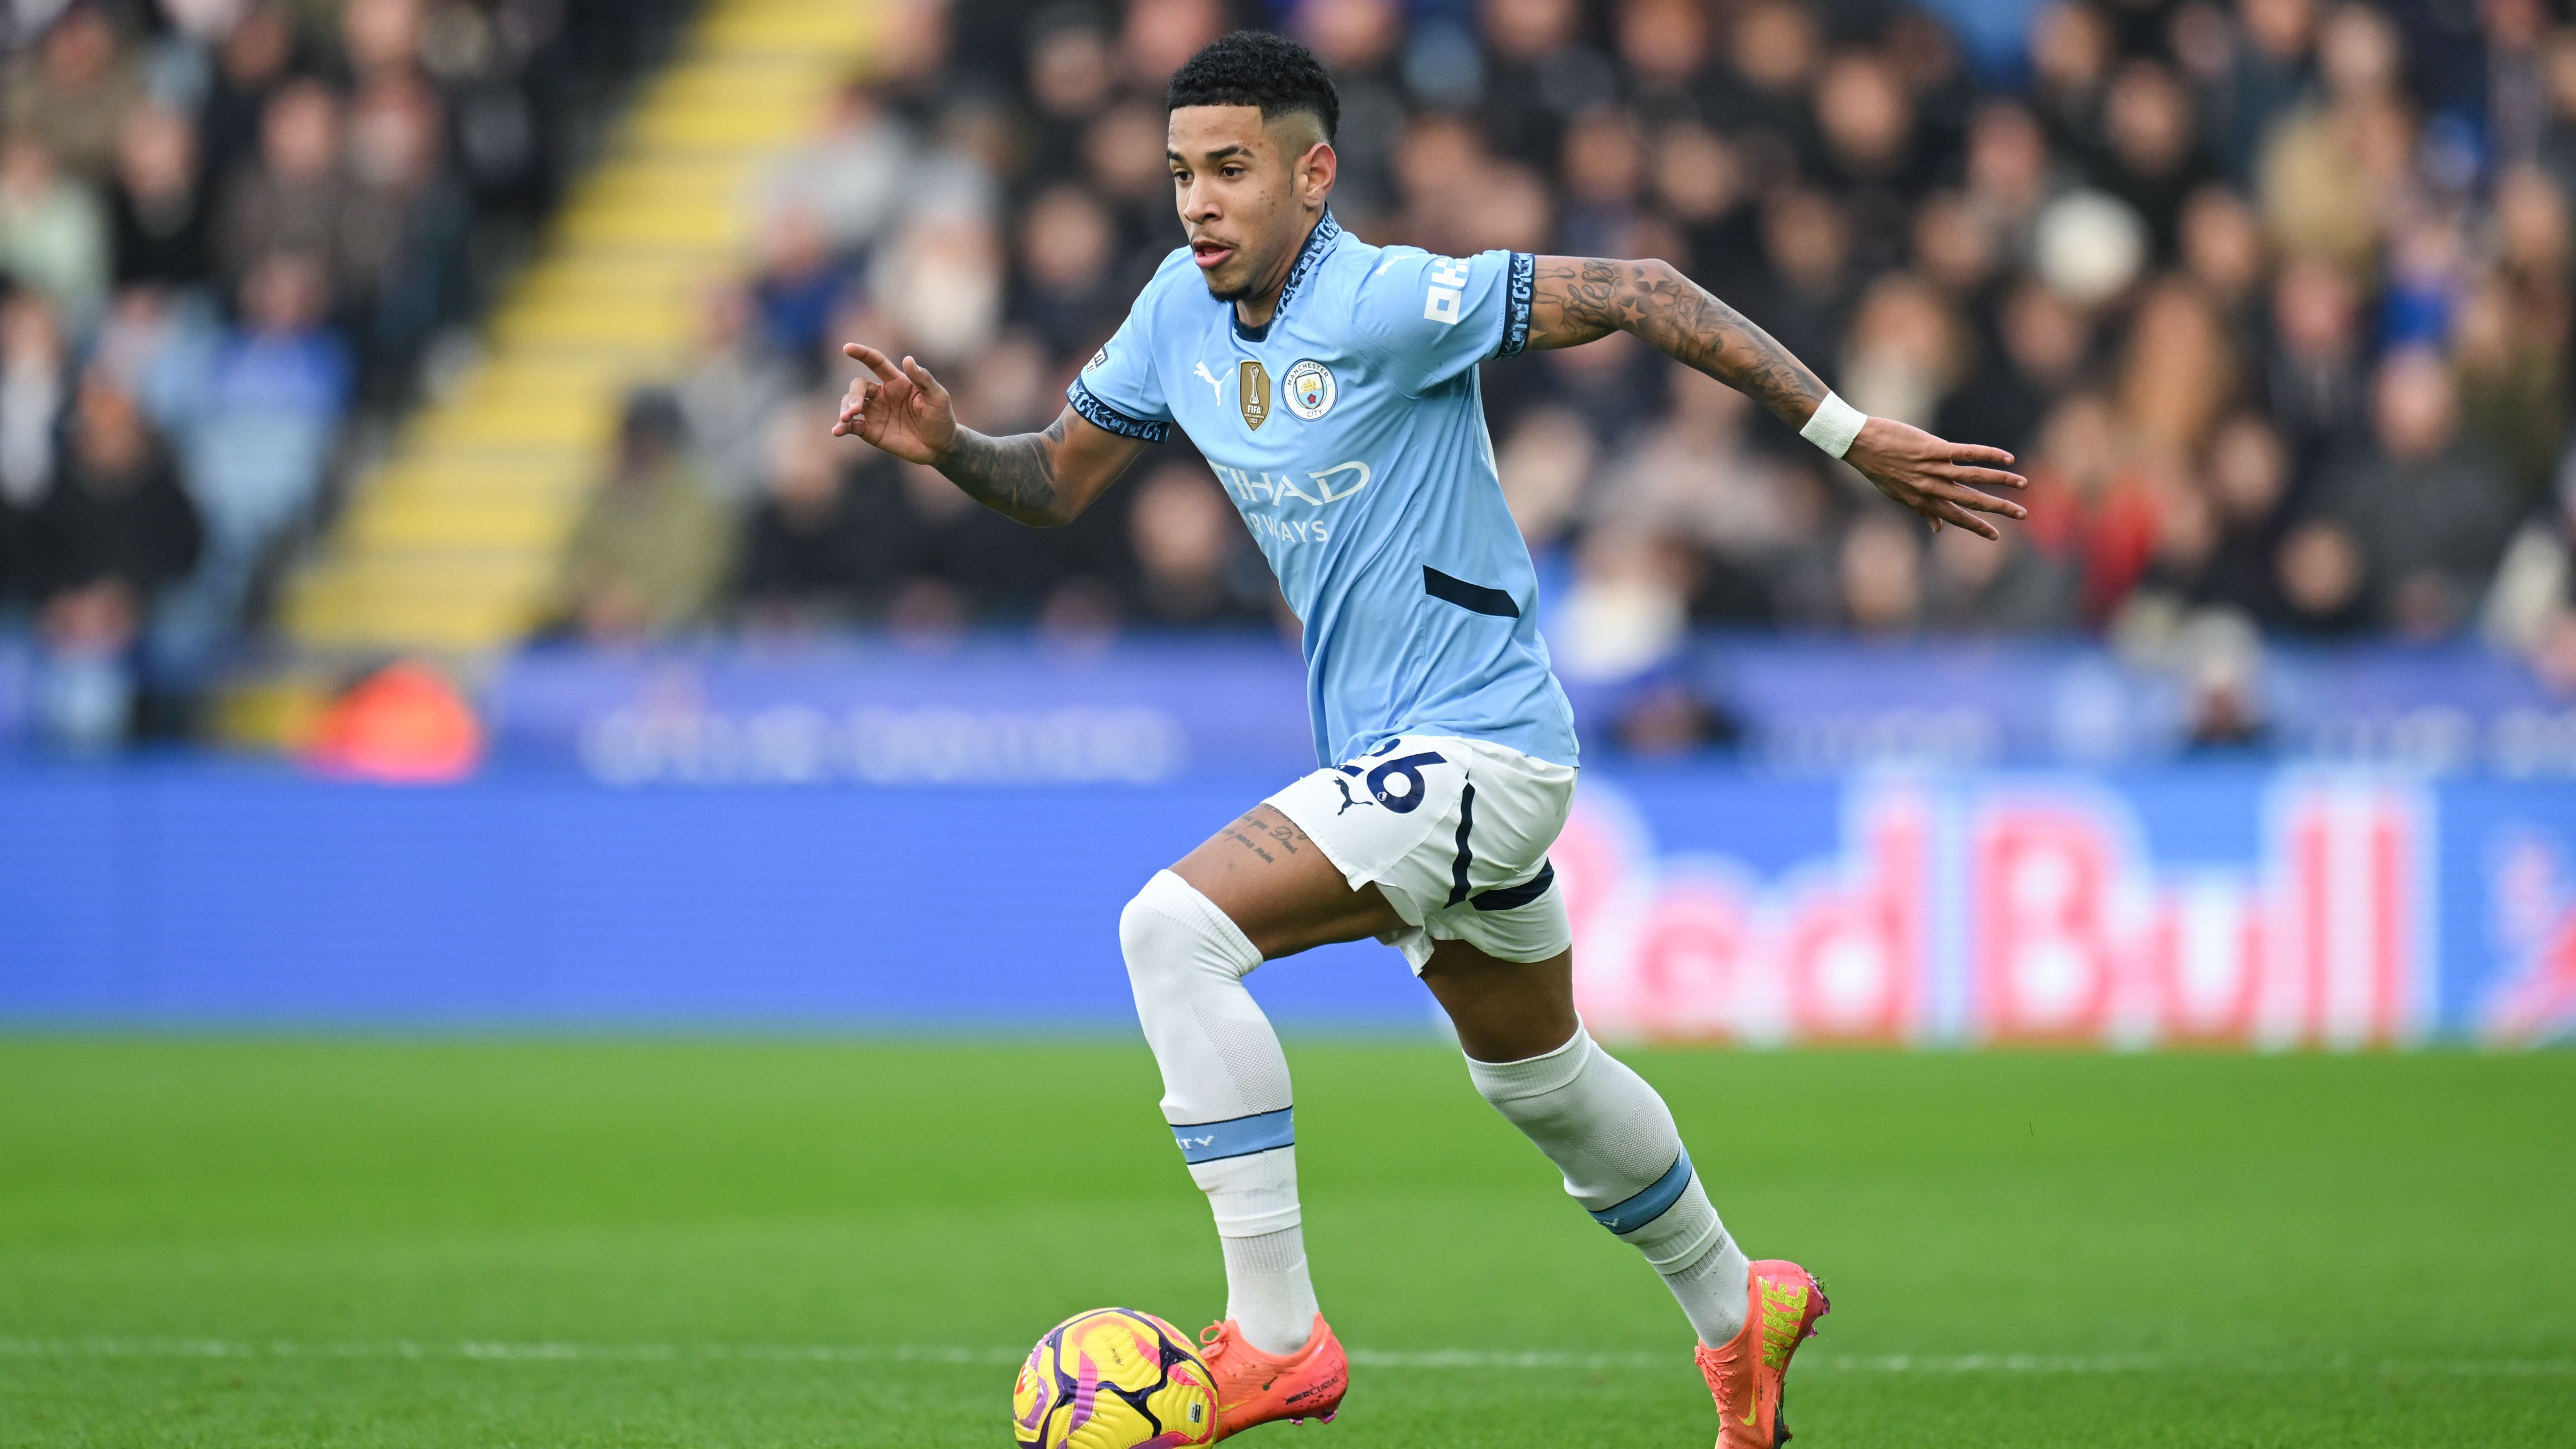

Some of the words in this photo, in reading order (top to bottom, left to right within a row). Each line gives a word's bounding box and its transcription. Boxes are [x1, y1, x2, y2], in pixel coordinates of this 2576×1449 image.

[1287, 363, 1329, 386] MANCHESTER
[1247, 405, 1262, 414] FIFA
[1207, 458, 1370, 506] TIHAD
[1241, 511, 1329, 542] IRWAYS
[1975, 785, 2409, 1044] Bull
[1761, 1277, 1809, 1371] NIKE
